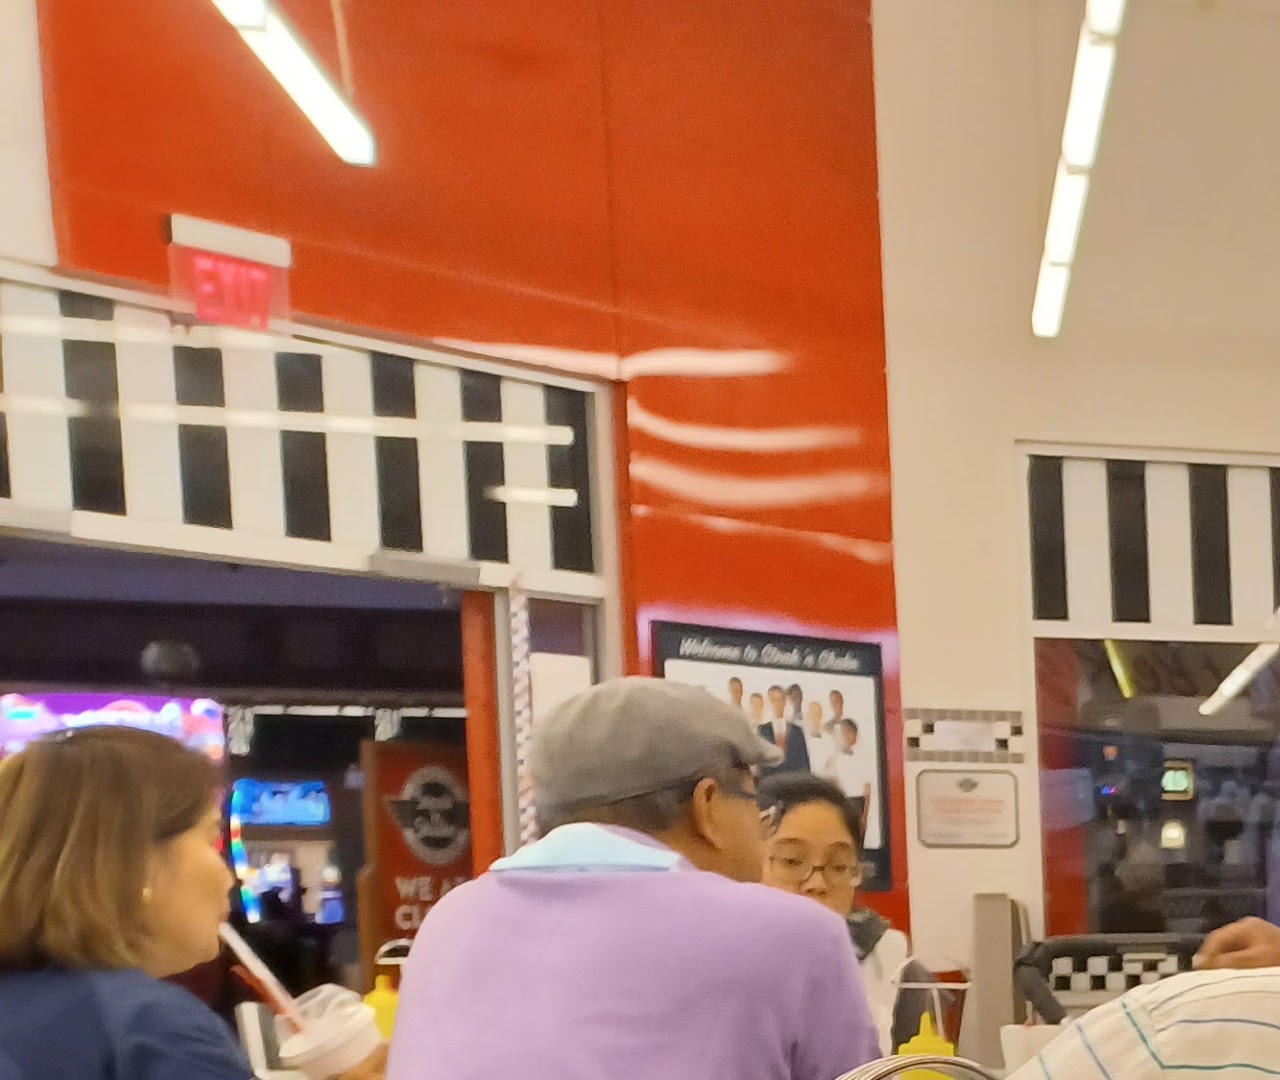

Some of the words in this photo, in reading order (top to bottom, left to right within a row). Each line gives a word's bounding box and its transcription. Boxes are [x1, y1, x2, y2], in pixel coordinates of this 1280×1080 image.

[193, 255, 271, 331] EXIT
[679, 637, 743, 663] Welcome
[743, 643, 758, 664] to
